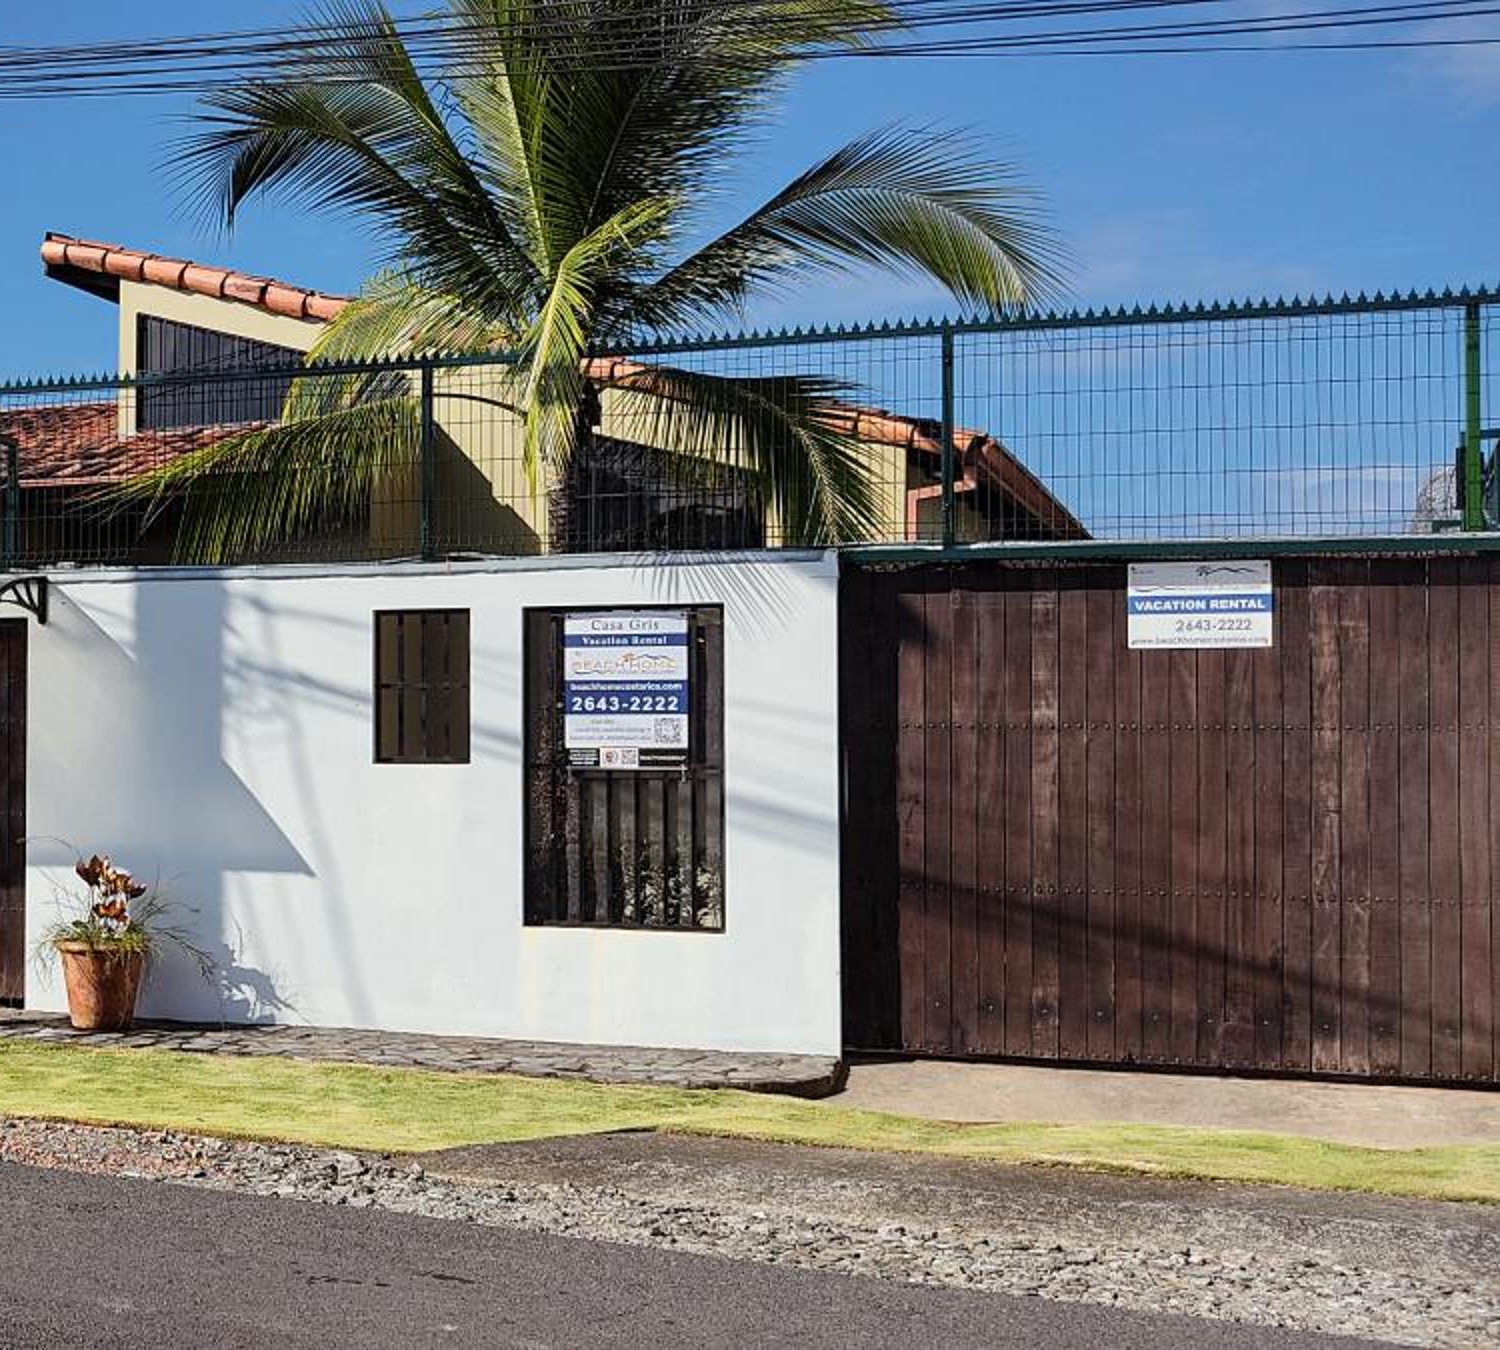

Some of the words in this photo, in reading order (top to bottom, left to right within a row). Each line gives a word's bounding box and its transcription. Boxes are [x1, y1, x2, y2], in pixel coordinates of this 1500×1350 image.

[1134, 600, 1206, 611] VACATION
[1209, 599, 1266, 609] RENTAL
[591, 620, 623, 631] Casa
[629, 619, 660, 631] Gris
[1175, 619, 1253, 632] 2643-2222
[582, 636, 628, 645] Vacation
[631, 636, 667, 645] Rental
[571, 660, 625, 671] BEACH
[630, 660, 676, 671] HOME
[572, 697, 679, 711] 2643-2222
